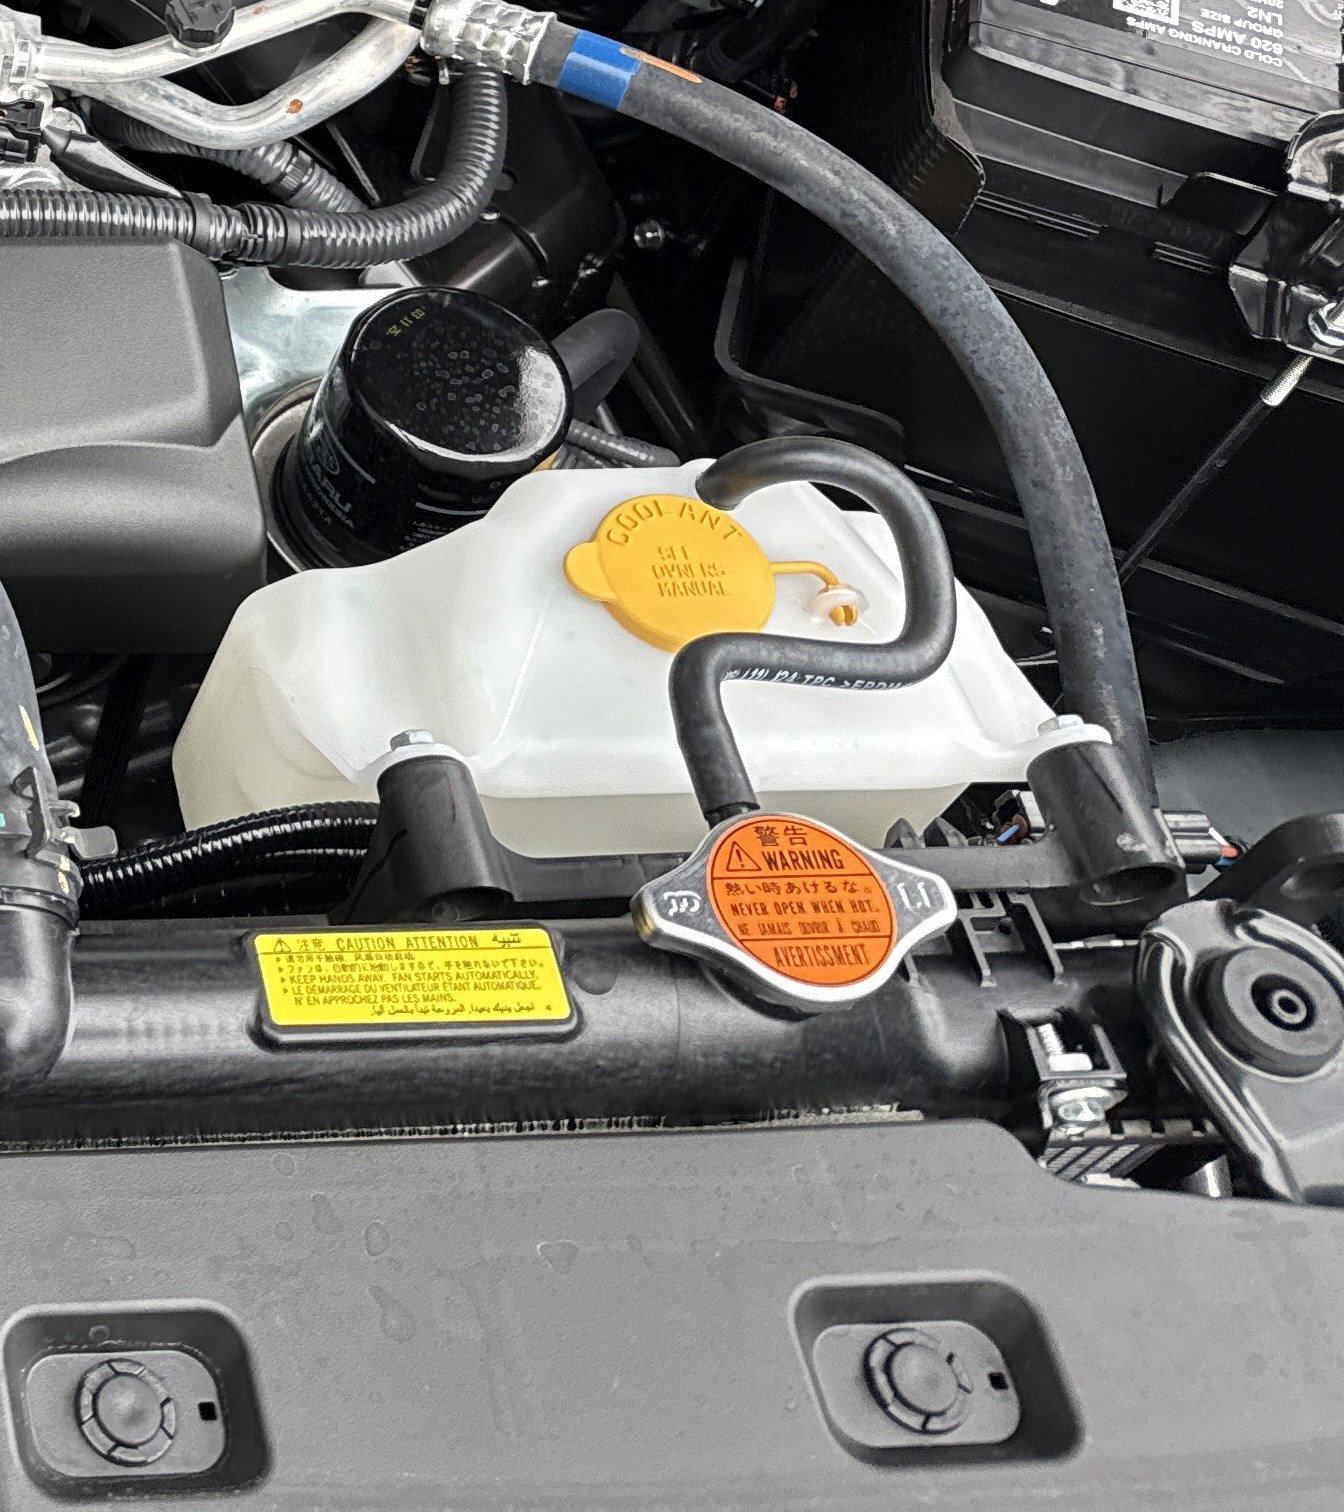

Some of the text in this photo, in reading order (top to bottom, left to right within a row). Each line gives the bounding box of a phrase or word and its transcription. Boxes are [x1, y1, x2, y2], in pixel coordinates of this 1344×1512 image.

[1200, 8, 1284, 39] GROUP SIZE
[1247, 5, 1283, 26] LN2
[1126, 16, 1283, 67] COLD CRANKING AMPS
[1191, 20, 1247, 45] AMPS
[754, 824, 808, 847] 警告
[761, 848, 844, 872] WARNING
[730, 902, 769, 916] NEVER
[774, 900, 805, 915] OPEN
[810, 899, 845, 914] WHEN
[336, 937, 396, 951] CAUTION
[406, 935, 480, 950] ATTENTION
[290, 974, 316, 985] KEEP
[319, 974, 355, 984] HANDS
[392, 972, 412, 982] FAN
[415, 971, 452, 982] STARTS
[364, 984, 377, 993] DU
[306, 995, 320, 1006] EN
[381, 993, 400, 1004] PAS
[402, 993, 420, 1003] LES
